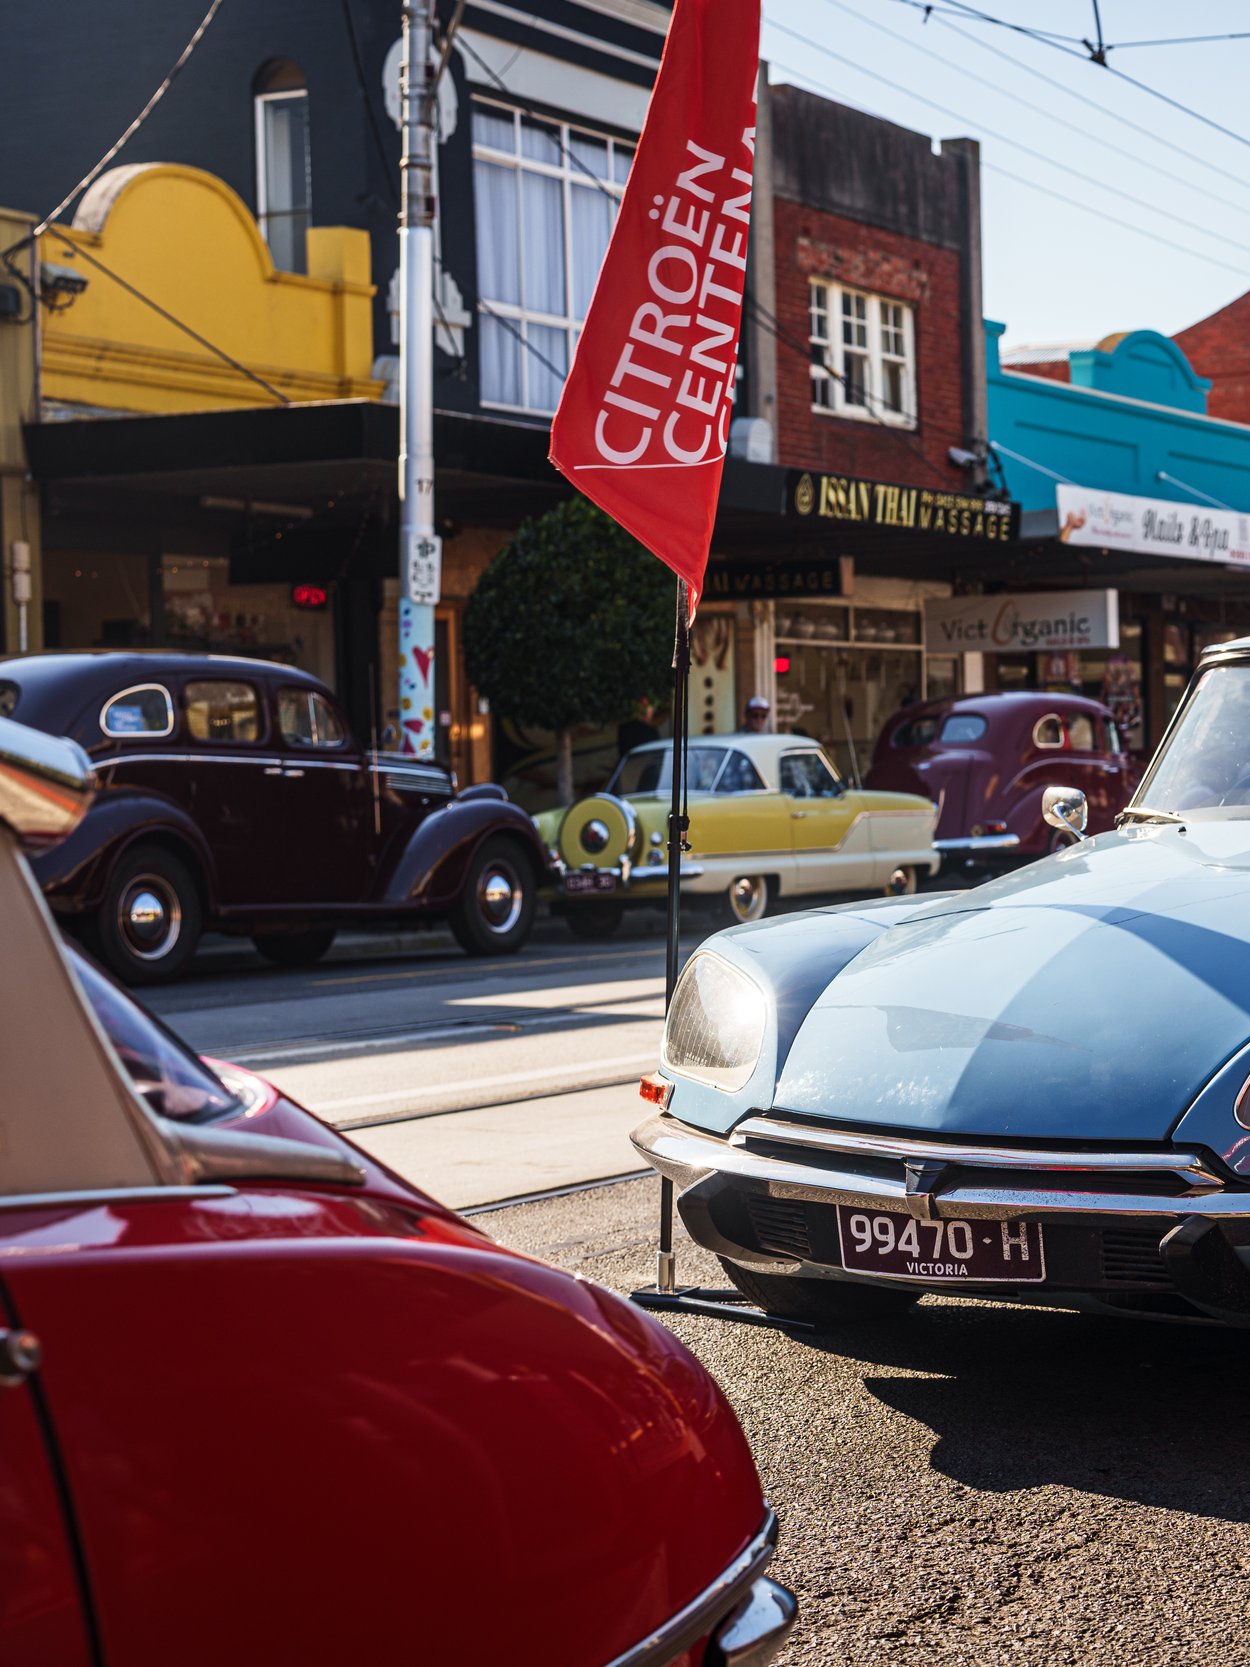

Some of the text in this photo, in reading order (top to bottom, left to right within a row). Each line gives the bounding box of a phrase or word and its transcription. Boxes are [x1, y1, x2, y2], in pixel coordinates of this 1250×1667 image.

[664, 68, 759, 464] CENTEN
[595, 139, 725, 464] CITROËN
[819, 475, 872, 520] ISSAN
[874, 483, 917, 528] THAI
[918, 506, 1010, 542] MASSAGE
[850, 1214, 974, 1260] 99470
[906, 1261, 968, 1276] VICTORIA
